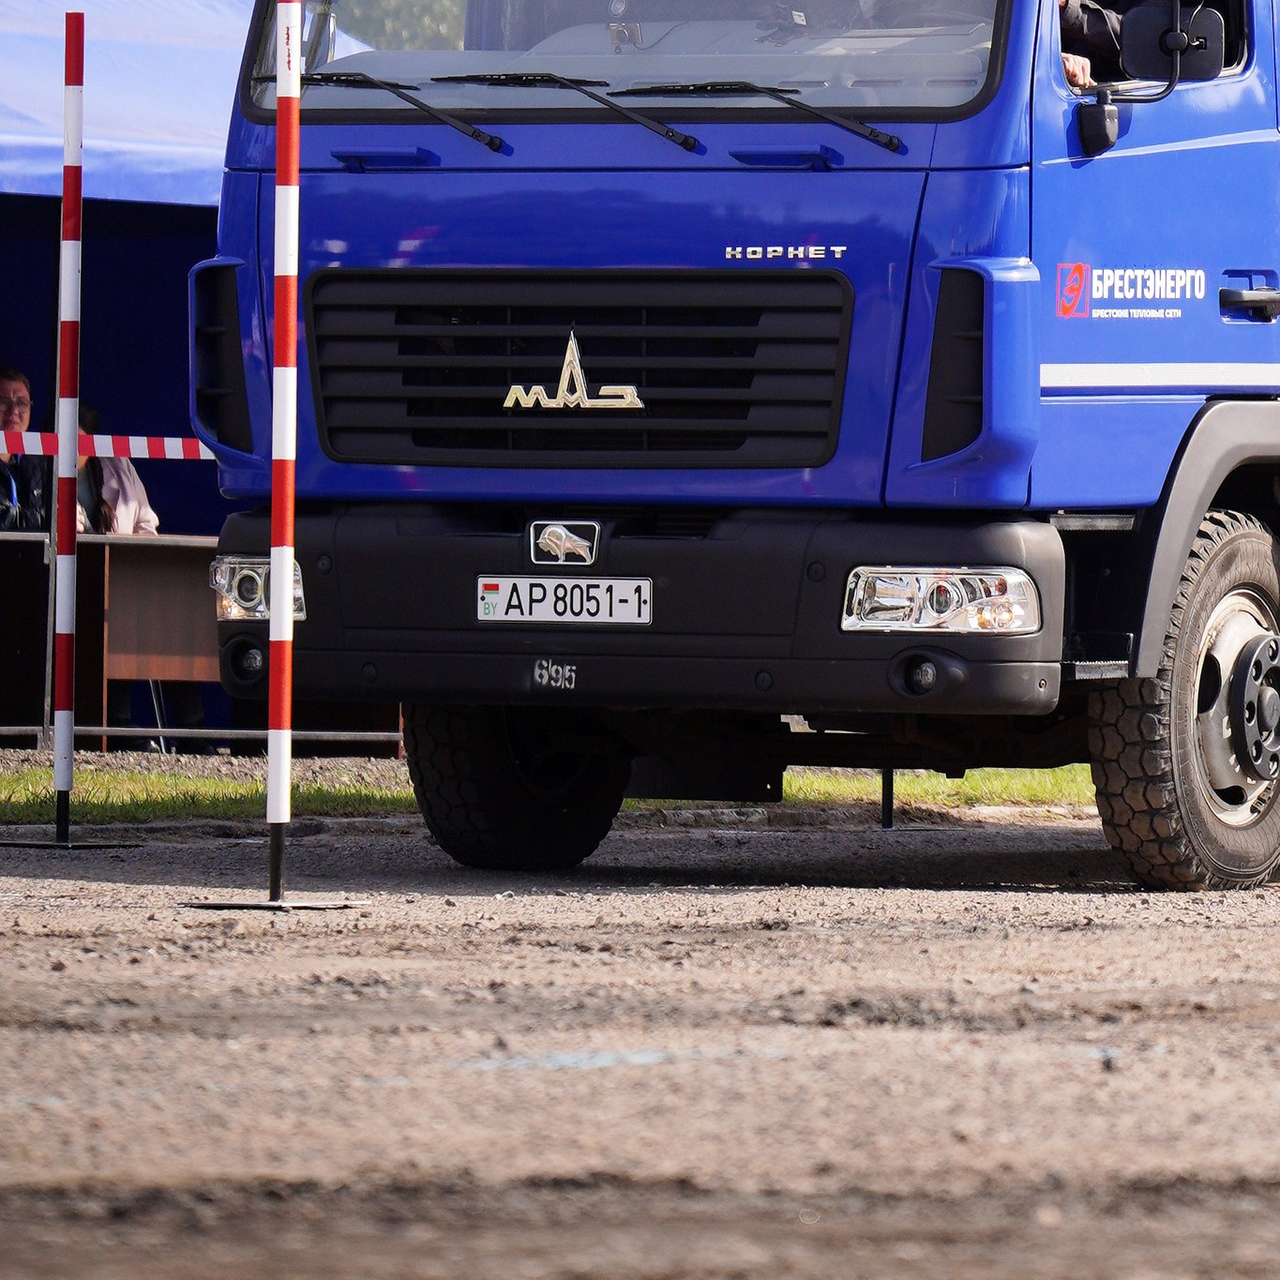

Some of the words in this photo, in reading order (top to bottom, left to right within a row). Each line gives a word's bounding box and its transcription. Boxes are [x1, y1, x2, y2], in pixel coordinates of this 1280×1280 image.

[725, 246, 847, 259] КОРНЕТ
[1092, 269, 1205, 299] БРЕСТЭНЕРГО
[503, 330, 646, 408] МАЗ
[483, 602, 498, 615] BY
